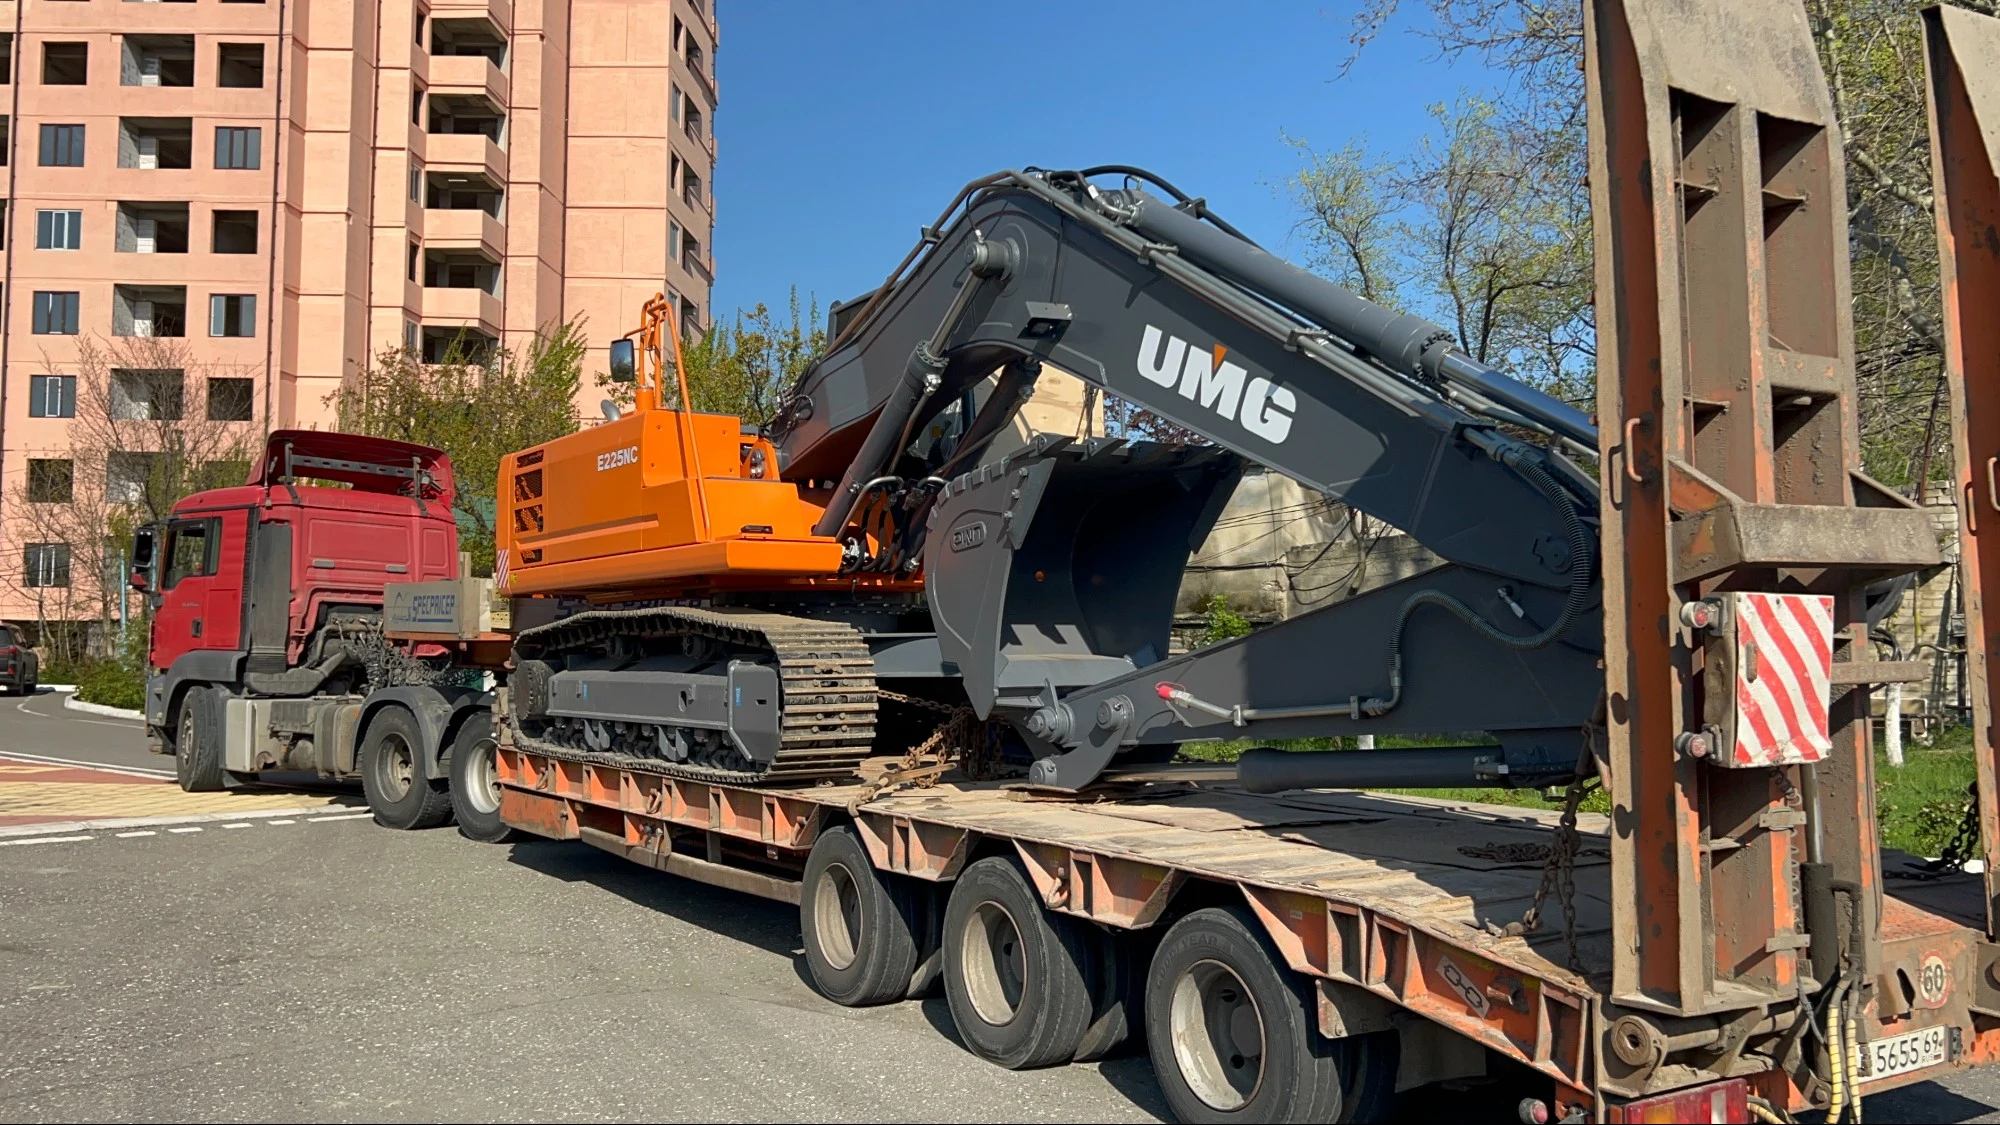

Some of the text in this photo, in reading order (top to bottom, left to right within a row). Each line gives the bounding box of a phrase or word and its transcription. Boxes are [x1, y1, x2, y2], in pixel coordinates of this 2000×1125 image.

[1137, 324, 1297, 445] UMG
[597, 445, 638, 472] E225NC
[1924, 964, 1945, 994] 60
[1877, 1030, 1939, 1073] 5655 69
